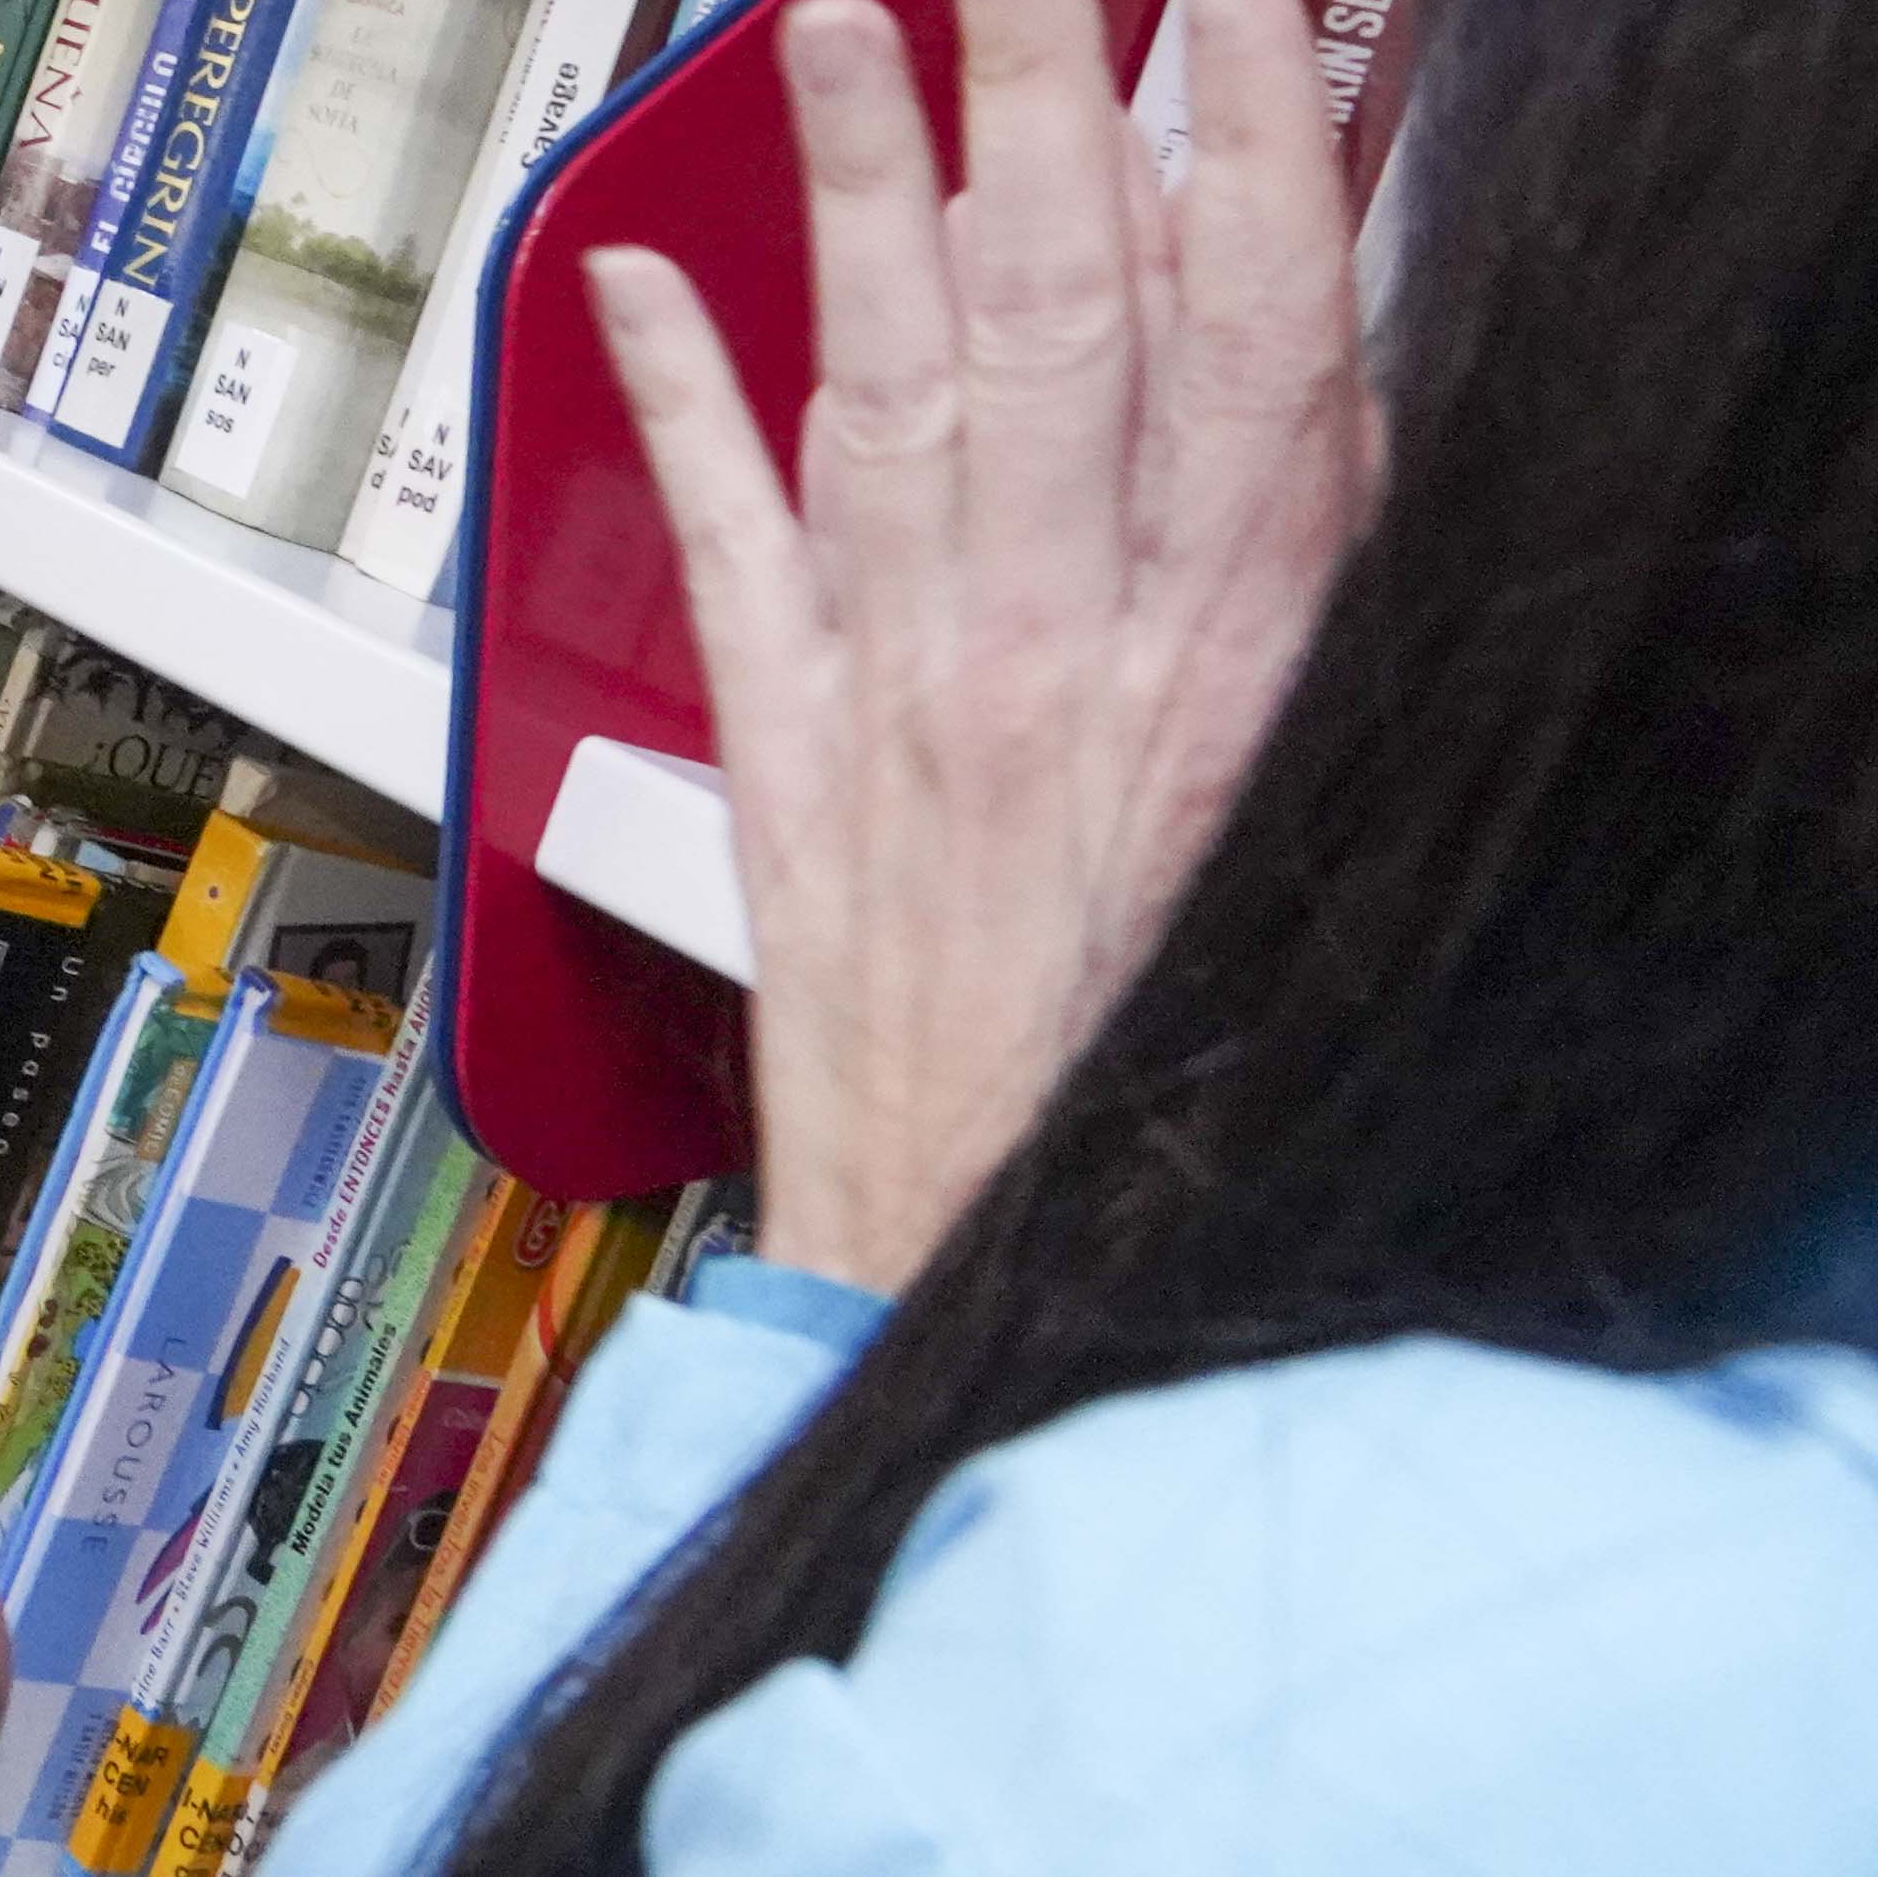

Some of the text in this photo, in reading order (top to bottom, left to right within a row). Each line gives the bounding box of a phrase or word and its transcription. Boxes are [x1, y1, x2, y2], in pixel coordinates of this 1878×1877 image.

[90, 219, 120, 256] EL
[114, 296, 130, 317] N
[95, 323, 131, 352] SAN
[86, 356, 115, 380] per
[236, 348, 251, 370] N
[214, 373, 252, 406] SAN
[204, 410, 234, 434] sos
[433, 424, 451, 447] N
[408, 450, 453, 483] SAV
[396, 484, 437, 514] pod
[310, 1205, 350, 1270] Desde
[332, 1097, 394, 1205] ENTONCES
[379, 1036, 419, 1097] hasta
[78, 1328, 187, 1562] LAROUSSE
[286, 1319, 403, 1556] Modela tus Animales
[149, 1336, 293, 1662] Barr Steve Williams Amy Husband
